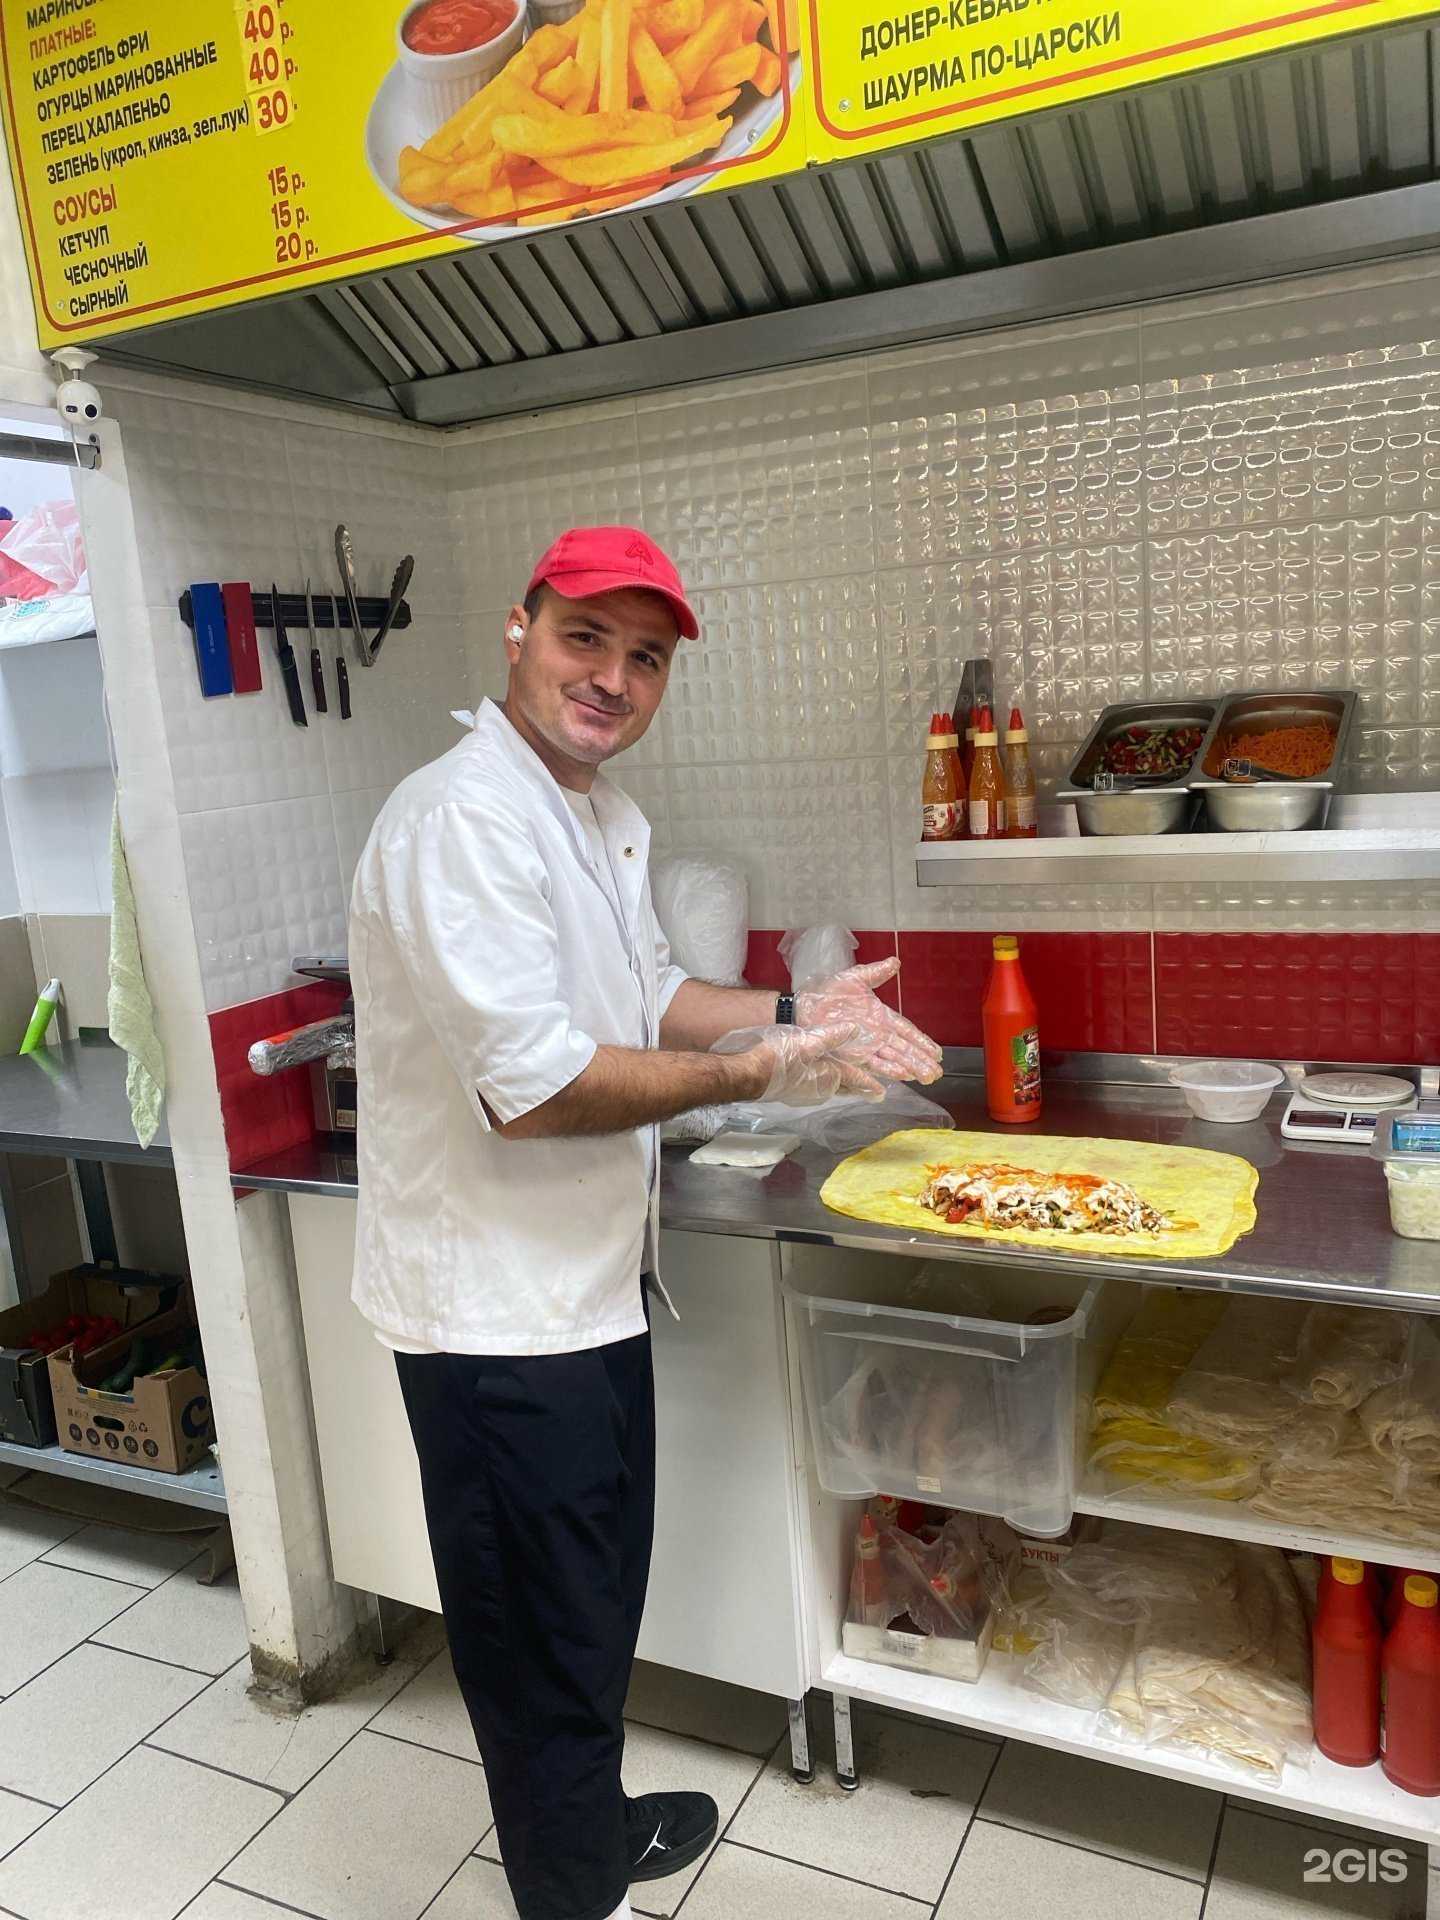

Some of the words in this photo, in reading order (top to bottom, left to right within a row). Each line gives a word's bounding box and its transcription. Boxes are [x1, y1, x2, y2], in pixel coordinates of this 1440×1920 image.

[29, 18, 97, 60] ПЛАТНЫЕ:
[244, 5, 274, 43] 40
[280, 22, 294, 44] р.
[33, 45, 115, 91] КАРТОФЕЛЬ
[117, 30, 149, 59] ФРИ
[249, 47, 279, 84] 40
[285, 58, 298, 80] р.
[864, 56, 966, 110] ШАУРМА
[971, 11, 1121, 80] ПО-ЦАРСКИ
[37, 85, 93, 122] ОГУРЦЫ
[94, 41, 218, 102] МАРИНОВАННЫЕ
[41, 120, 85, 153] ПЕРЕЦ
[87, 93, 171, 139] ХАЛАПЕНЬО
[257, 90, 288, 128] 30
[46, 151, 99, 185] ЗЕЛЕНЬ
[100, 141, 147, 171] (укроп,
[148, 125, 192, 152] кинза,
[193, 100, 249, 139] зел.лук)
[268, 166, 288, 196] 15
[292, 173, 305, 195] р.
[53, 184, 117, 225] СОУСЫ
[271, 200, 291, 229] 15
[296, 207, 309, 228] р.
[58, 225, 110, 257] КЕТЧУП
[276, 232, 301, 263] 20
[305, 239, 318, 260] р.
[64, 241, 148, 286] ЧЕСНОЧНЫЙ
[69, 279, 129, 317] СЫРНЫЙ
